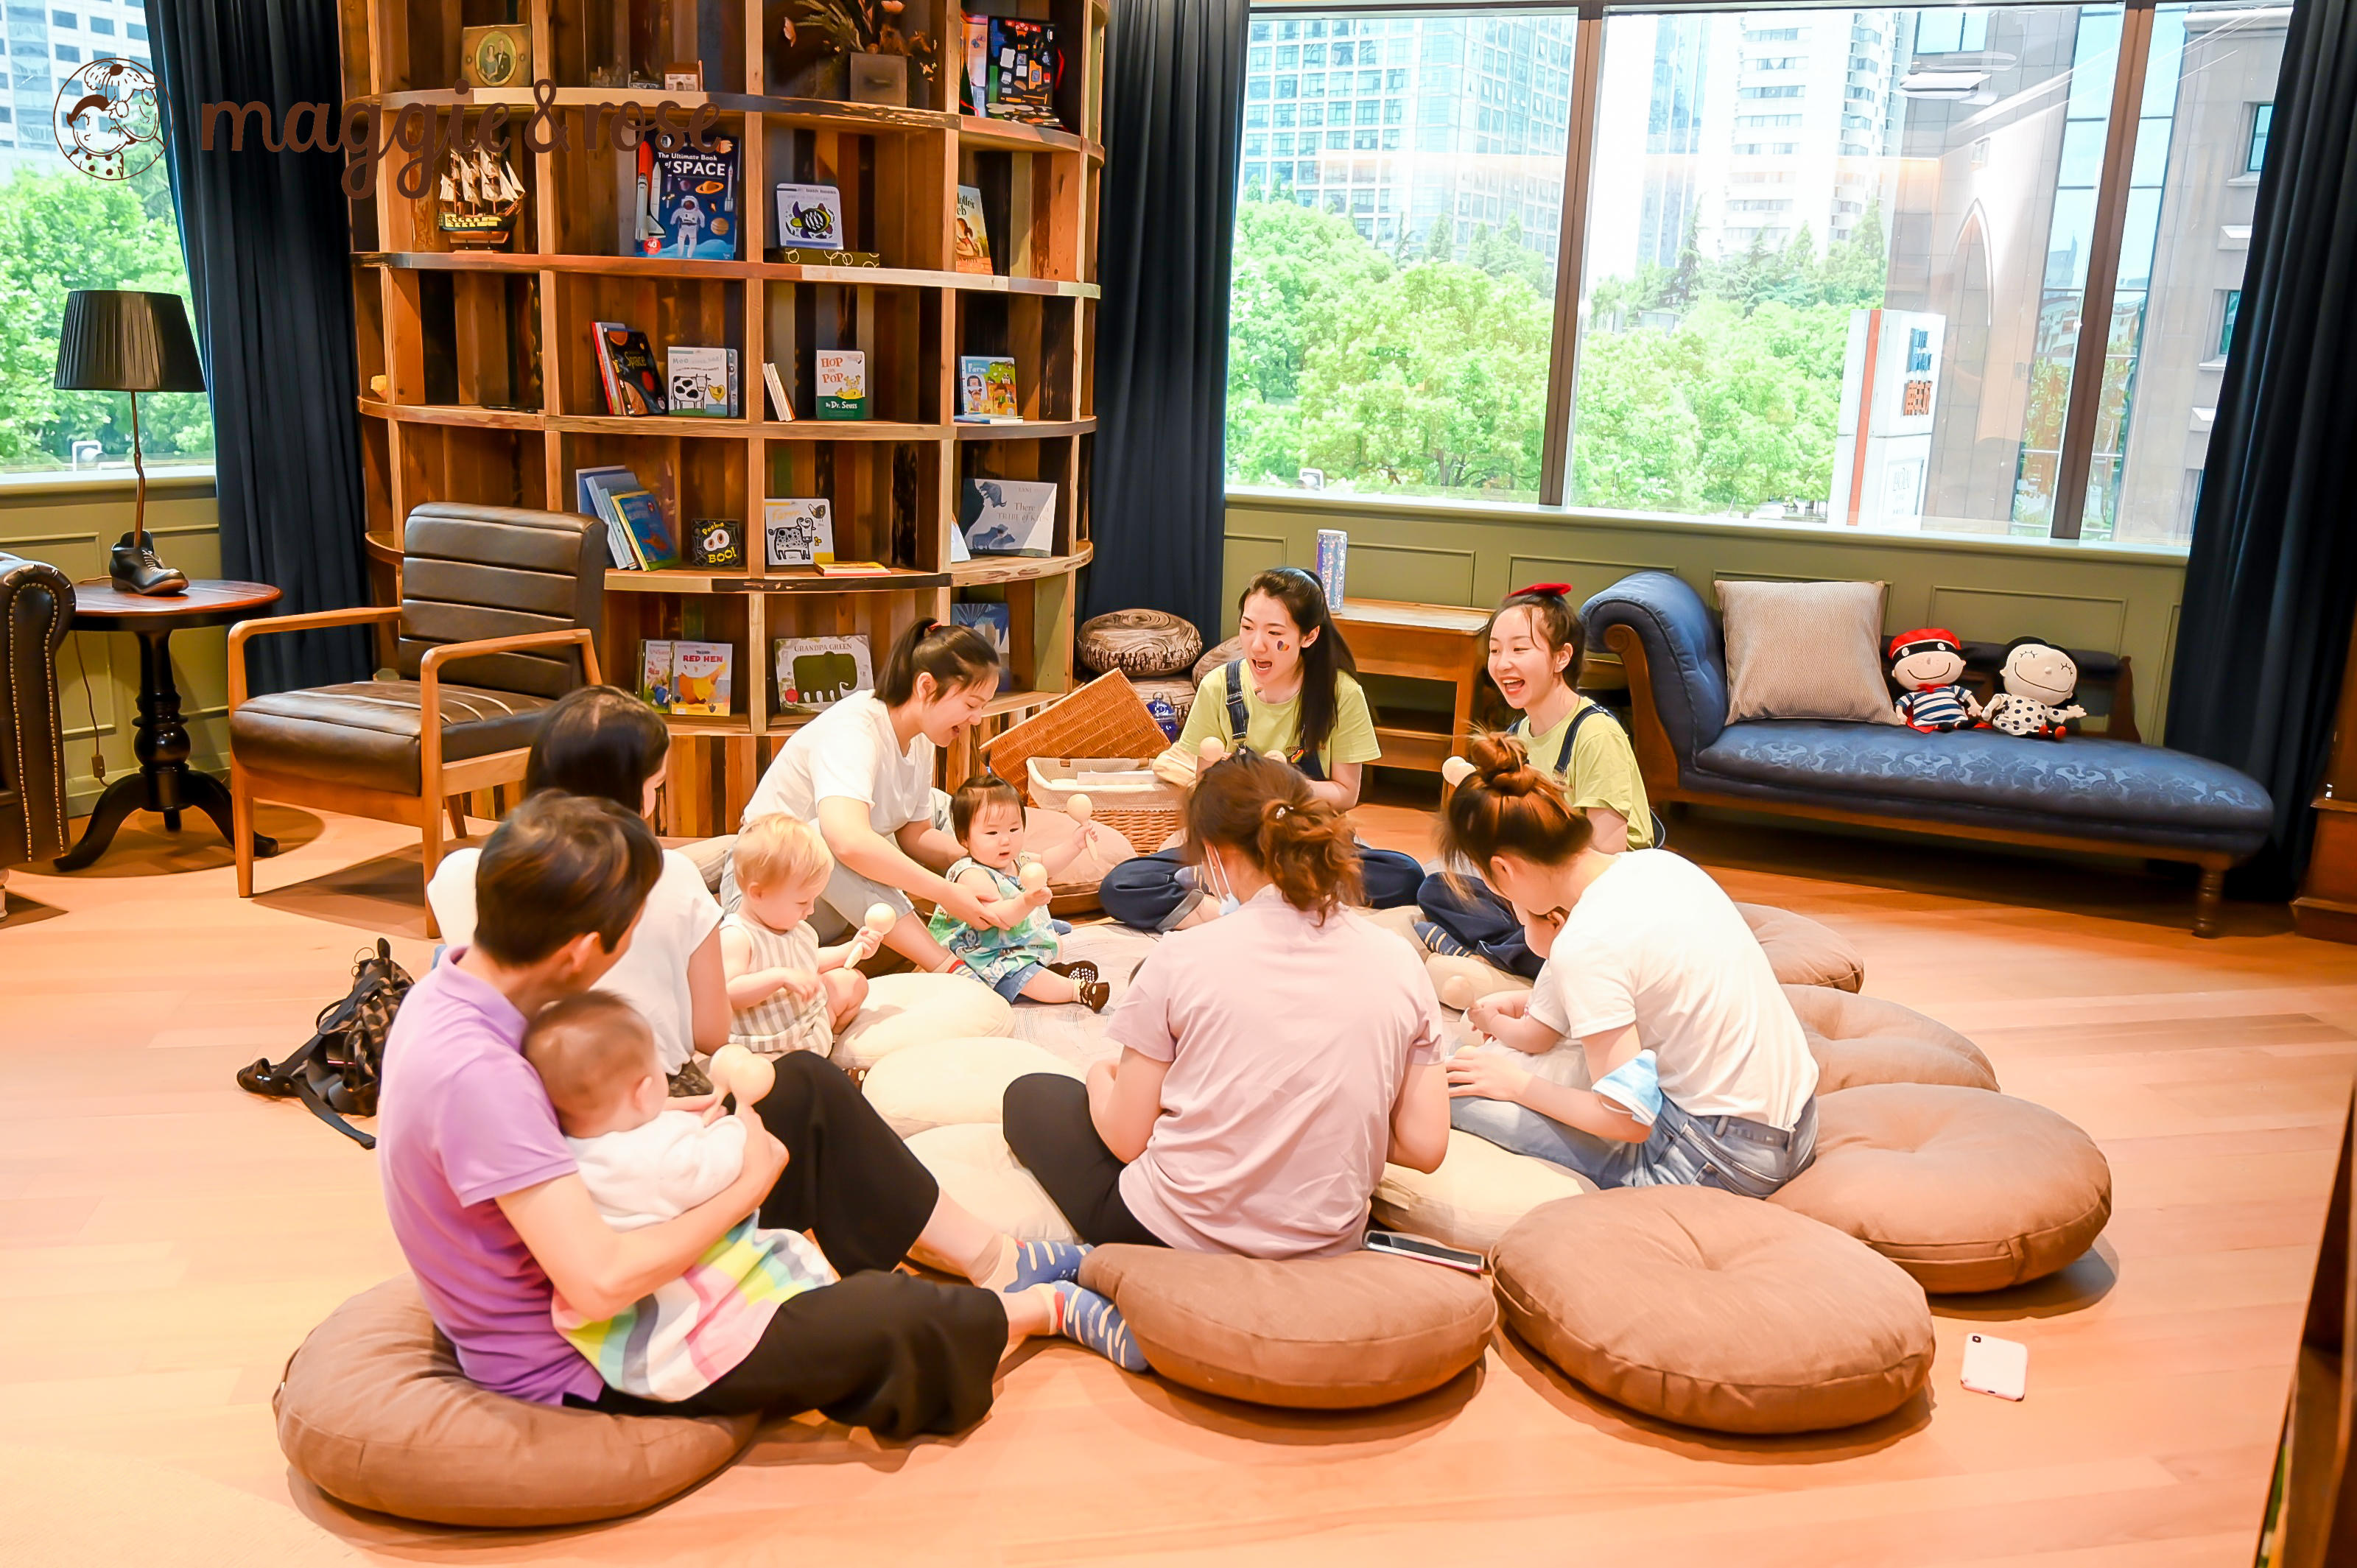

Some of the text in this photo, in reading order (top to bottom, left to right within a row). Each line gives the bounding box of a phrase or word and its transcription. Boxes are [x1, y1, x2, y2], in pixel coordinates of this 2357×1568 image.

[671, 152, 699, 161] Ultimate
[672, 161, 726, 176] SPACE
[821, 356, 843, 368] HOP
[821, 373, 843, 384] POP
[830, 401, 841, 409] Dr.
[841, 401, 858, 409] Seuss
[1014, 502, 1036, 512] There
[707, 546, 737, 563] BOO!
[794, 643, 852, 653] GRANDPA GREEN
